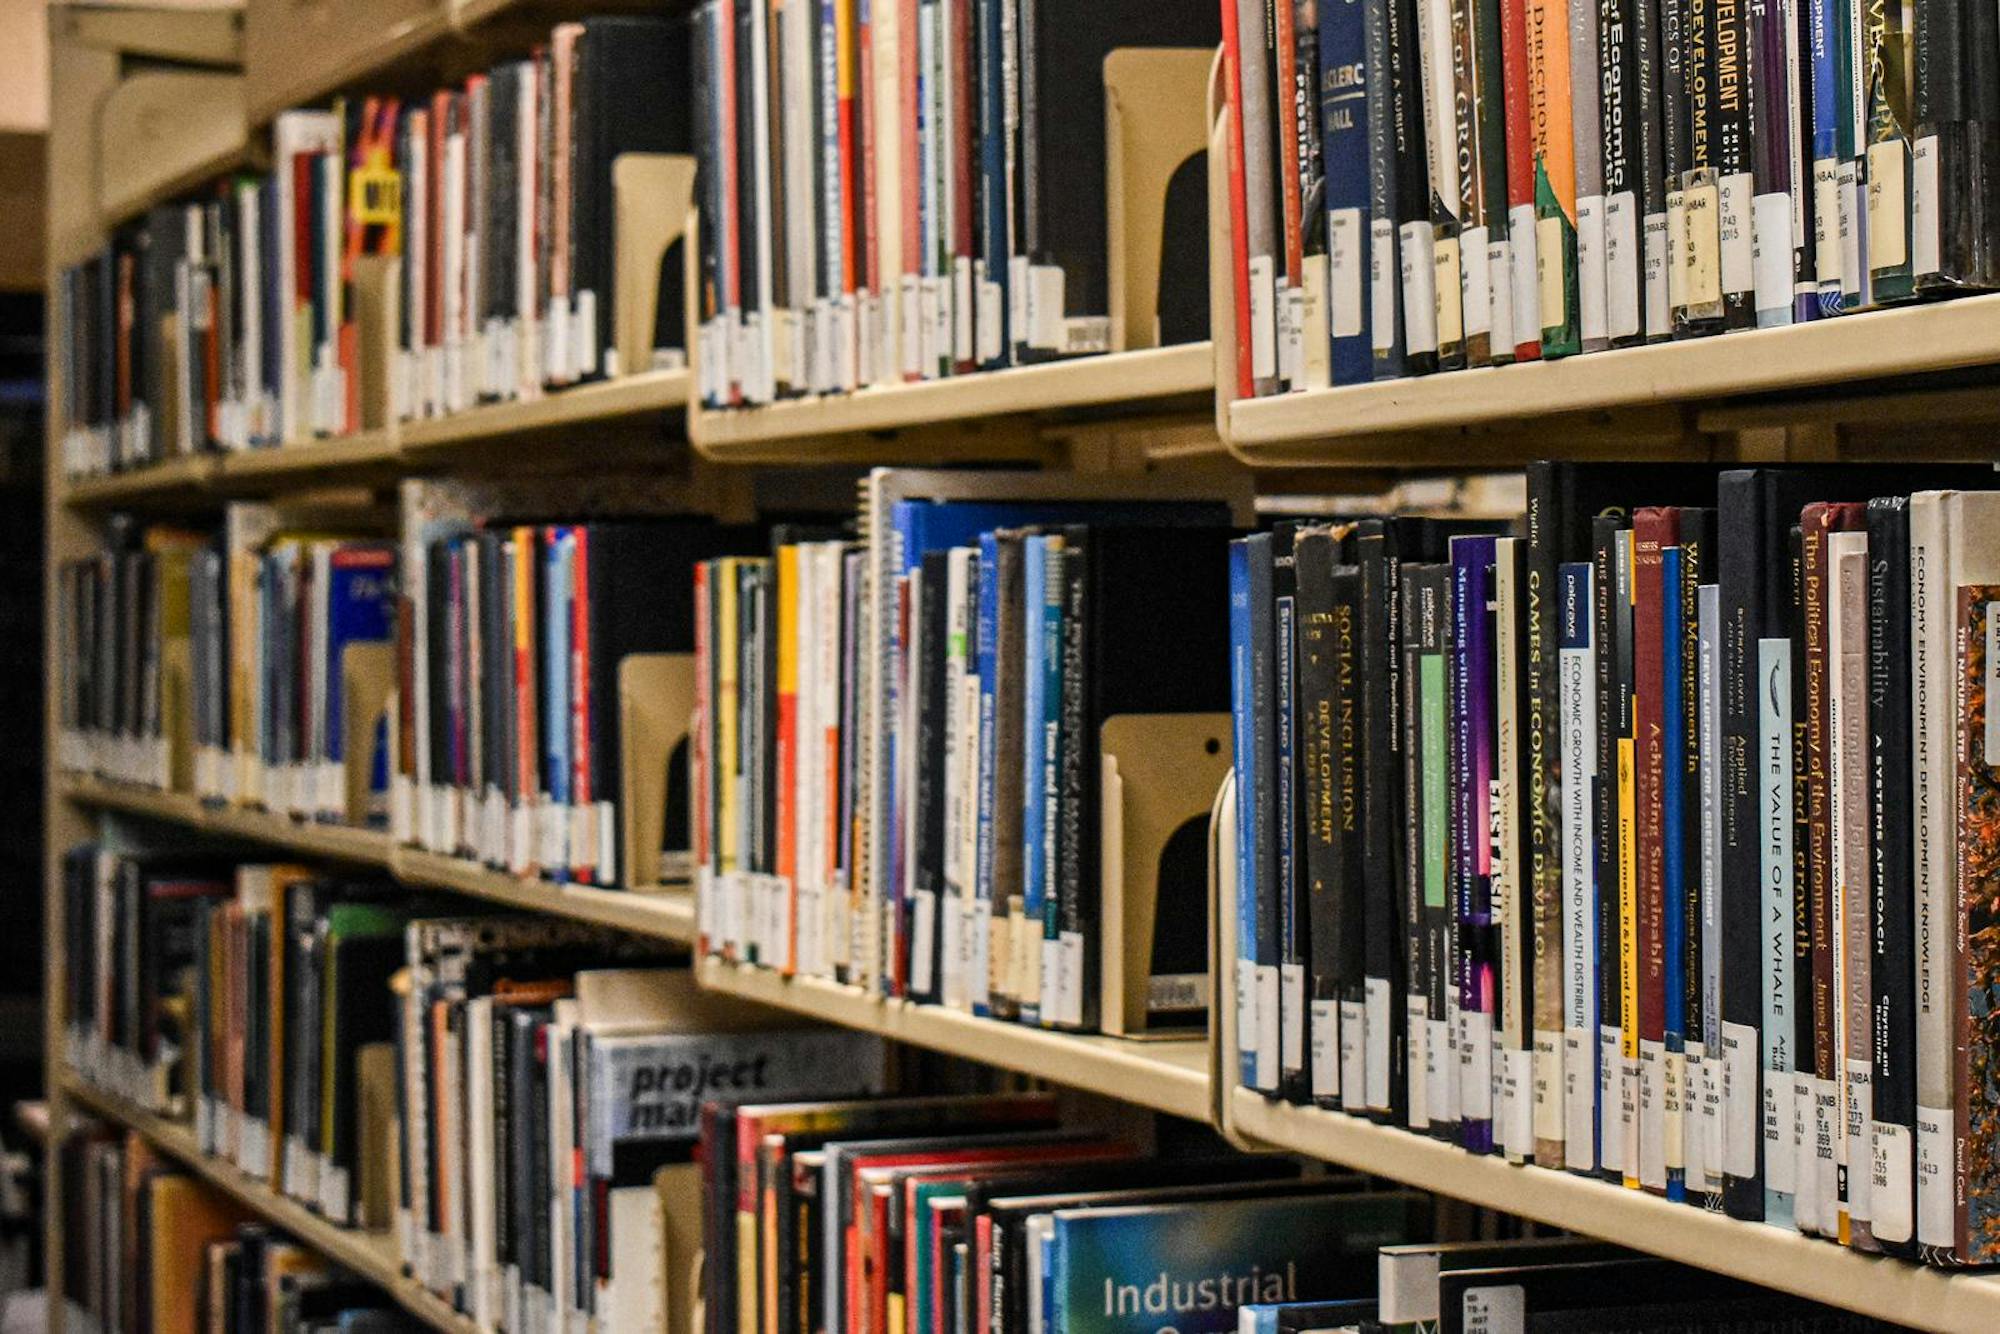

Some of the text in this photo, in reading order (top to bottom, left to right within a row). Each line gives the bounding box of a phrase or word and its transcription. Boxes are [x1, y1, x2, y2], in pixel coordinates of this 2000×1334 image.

[1533, 6, 1549, 161] DIRECTIONS
[1640, 58, 1651, 111] Riches
[1668, 46, 1681, 75] OF
[1693, 0, 1709, 173] DEVELOPMENT
[1394, 93, 1406, 154] SUBJECT
[1602, 20, 1616, 196] and Growth
[1611, 22, 1627, 187] Economic
[1529, 497, 1540, 549] Wydick
[1806, 530, 1820, 570] The
[1456, 566, 1470, 649] Managing
[1565, 574, 1577, 639] palgrave
[1686, 541, 1698, 616] Welfare
[1792, 557, 1800, 606] BOOTH
[1425, 586, 1436, 647] palgrave
[1529, 570, 1542, 663] GAMES
[1736, 607, 1745, 669] BATEMAN,
[1806, 575, 1822, 653] Political
[1870, 559, 1890, 709] Sustainability
[1957, 626, 1967, 654] THE
[1388, 556, 1400, 752] State Building and Development
[1458, 651, 1470, 716] without
[1530, 671, 1543, 690] in
[1687, 621, 1699, 749] Measurement
[1702, 653, 1712, 685] NEW
[1339, 604, 1355, 832] SOCIAL INCLUSION
[1598, 545, 1610, 864] THE FORCES OF ECONOMIC GROWTH
[1806, 658, 1823, 753] Economy
[1957, 657, 1966, 726] NATURAL
[1045, 720, 1059, 761] Time
[1280, 607, 1290, 849] SUBSISTENCE AND ECONOMIC
[1702, 689, 1713, 764] BLUEPRINT
[1957, 729, 1966, 763] STEP
[1045, 763, 1059, 795] and
[1319, 699, 1332, 844] DEVELOPMENT
[1531, 697, 1545, 845] ECONOMIC
[1688, 754, 1699, 773] in
[1704, 766, 1713, 795] FOR
[1726, 735, 1738, 848] Environmental
[1735, 734, 1747, 796] Applied
[1811, 757, 1825, 780] of
[1811, 783, 1825, 808] the
[1917, 545, 1930, 1015] ECONOMY ENVIRONMENT DEVELOPMENT KNOWLEDGE
[1460, 790, 1471, 851] Second
[1501, 782, 1512, 850] WORKS
[1571, 655, 1585, 960] ECONOMIC GROWTH WITH INCOME AND WEALTH
[1875, 754, 1885, 840] SYSTEMS
[1957, 775, 1966, 824] Towards
[1045, 796, 1059, 900] Management
[1621, 817, 1631, 912] Investment,
[1639, 773, 1649, 925] Development
[1649, 722, 1662, 979] Achieving Sustainable
[1704, 809, 1714, 857] GREEN
[1792, 721, 1811, 958] hooked growth
[1461, 854, 1473, 917] Edition
[1705, 858, 1715, 927] ECONOMY
[1770, 733, 1784, 1018] THE VALUE OF A WHALE
[1813, 821, 1828, 951] Environment
[1876, 847, 1886, 955] APPROACH
[1958, 841, 1967, 908] Sustainable
[1957, 911, 1966, 954] Society
[1464, 949, 1474, 985] Peter
[1623, 960, 1632, 991] and
[1815, 977, 1828, 1027] James
[1882, 995, 1890, 1048] Clayton
[630, 1052, 769, 1106] project
[1955, 1137, 1965, 1172] David
[1956, 1175, 1966, 1206] Cook
[1103, 1258, 1299, 1316] Industrial
